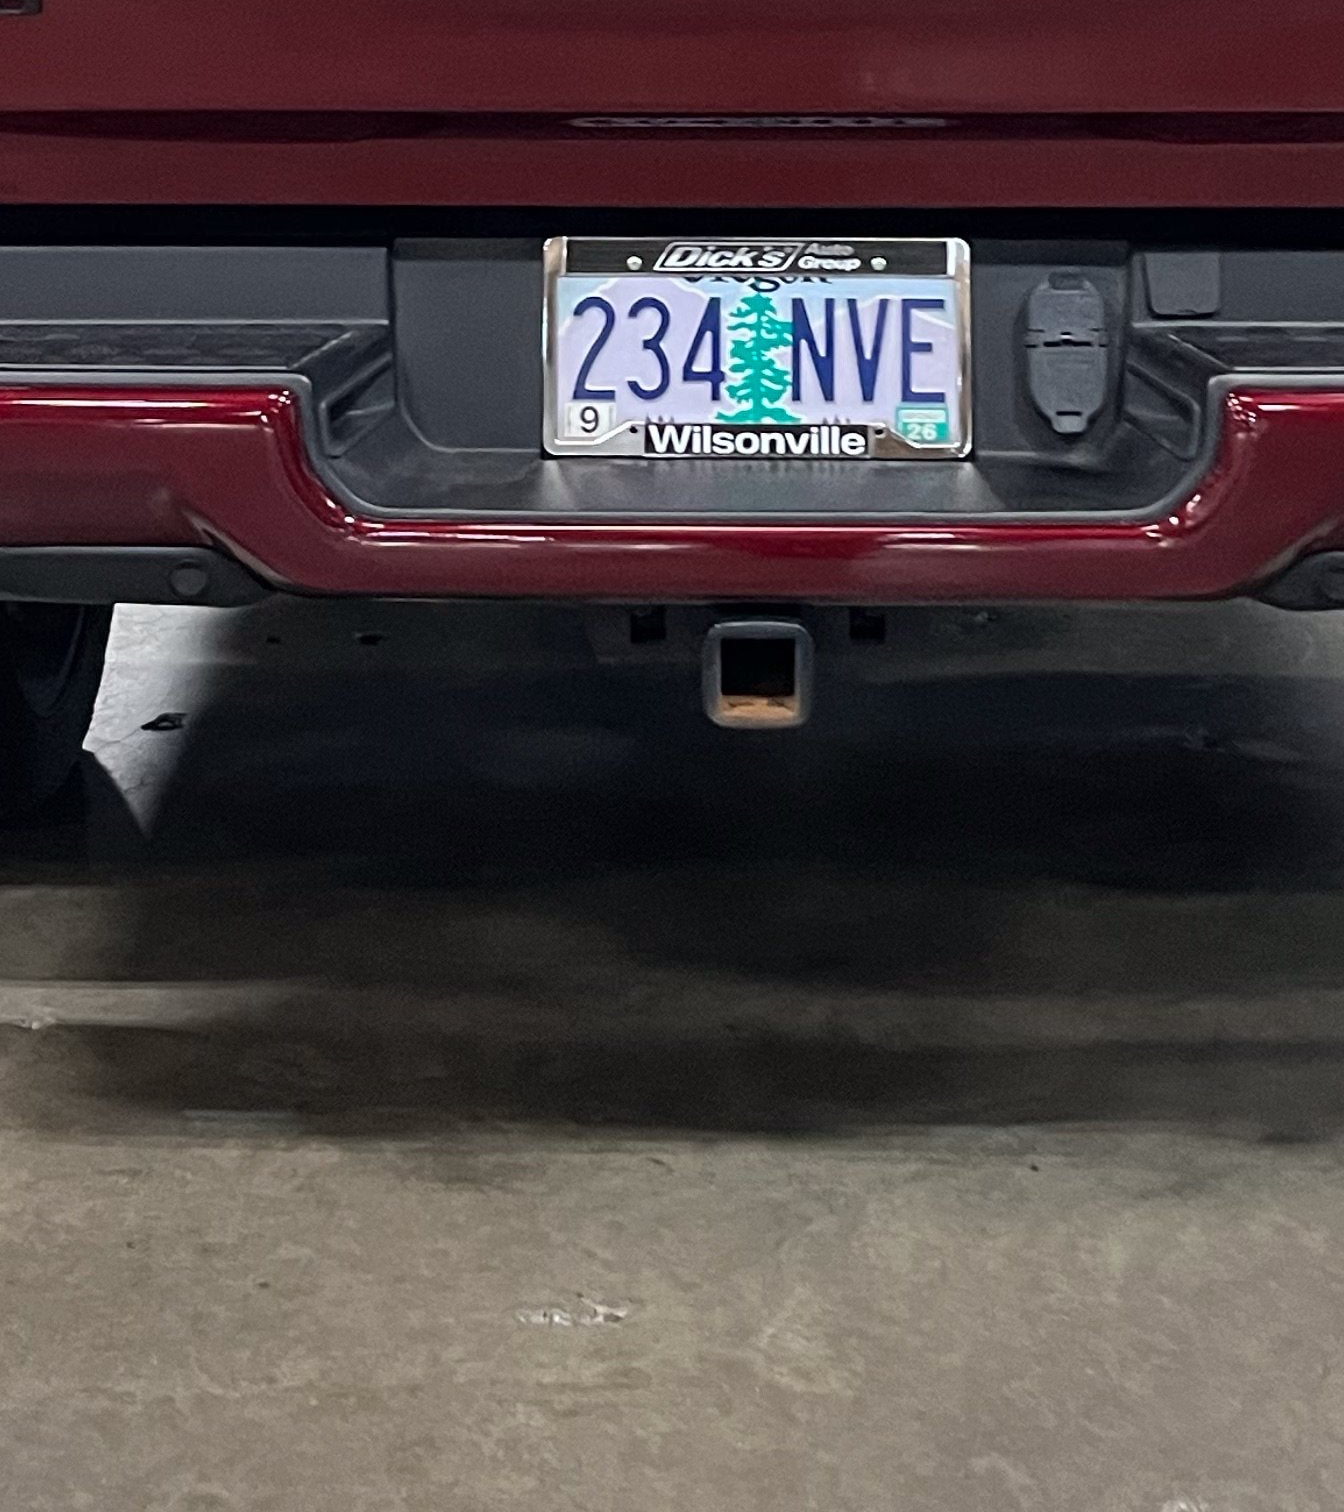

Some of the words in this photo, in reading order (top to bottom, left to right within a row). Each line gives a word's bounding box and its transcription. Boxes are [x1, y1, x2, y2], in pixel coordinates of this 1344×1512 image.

[663, 246, 789, 268] Dick's
[805, 243, 855, 255] Auto
[798, 256, 862, 272] Group
[572, 296, 726, 402] 234
[792, 298, 946, 403] NVE
[579, 405, 600, 434] 9
[906, 423, 937, 441] 26
[646, 424, 866, 456] Wilsonville
